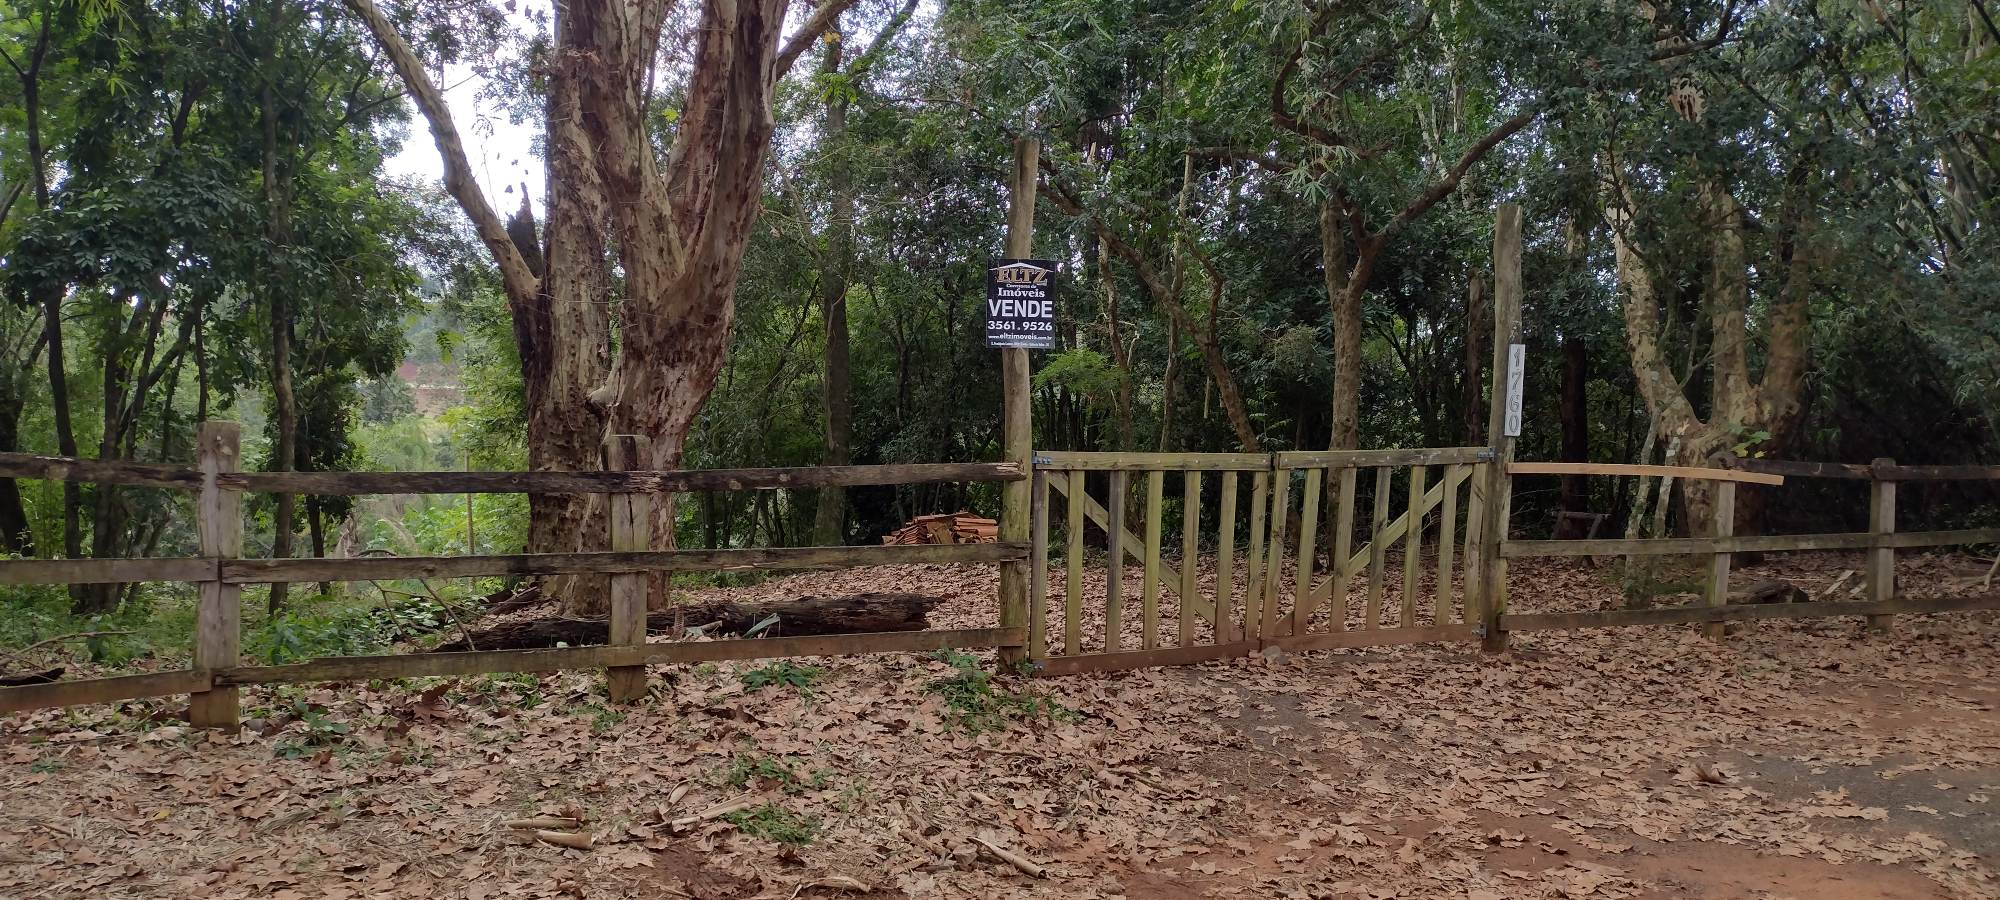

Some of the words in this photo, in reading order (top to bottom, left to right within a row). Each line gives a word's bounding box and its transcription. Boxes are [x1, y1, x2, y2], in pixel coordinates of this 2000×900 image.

[996, 268, 1047, 286] ELTZ
[998, 287, 1045, 298] Imóveis
[988, 299, 1053, 318] VENDE
[1509, 347, 1522, 433] 1760
